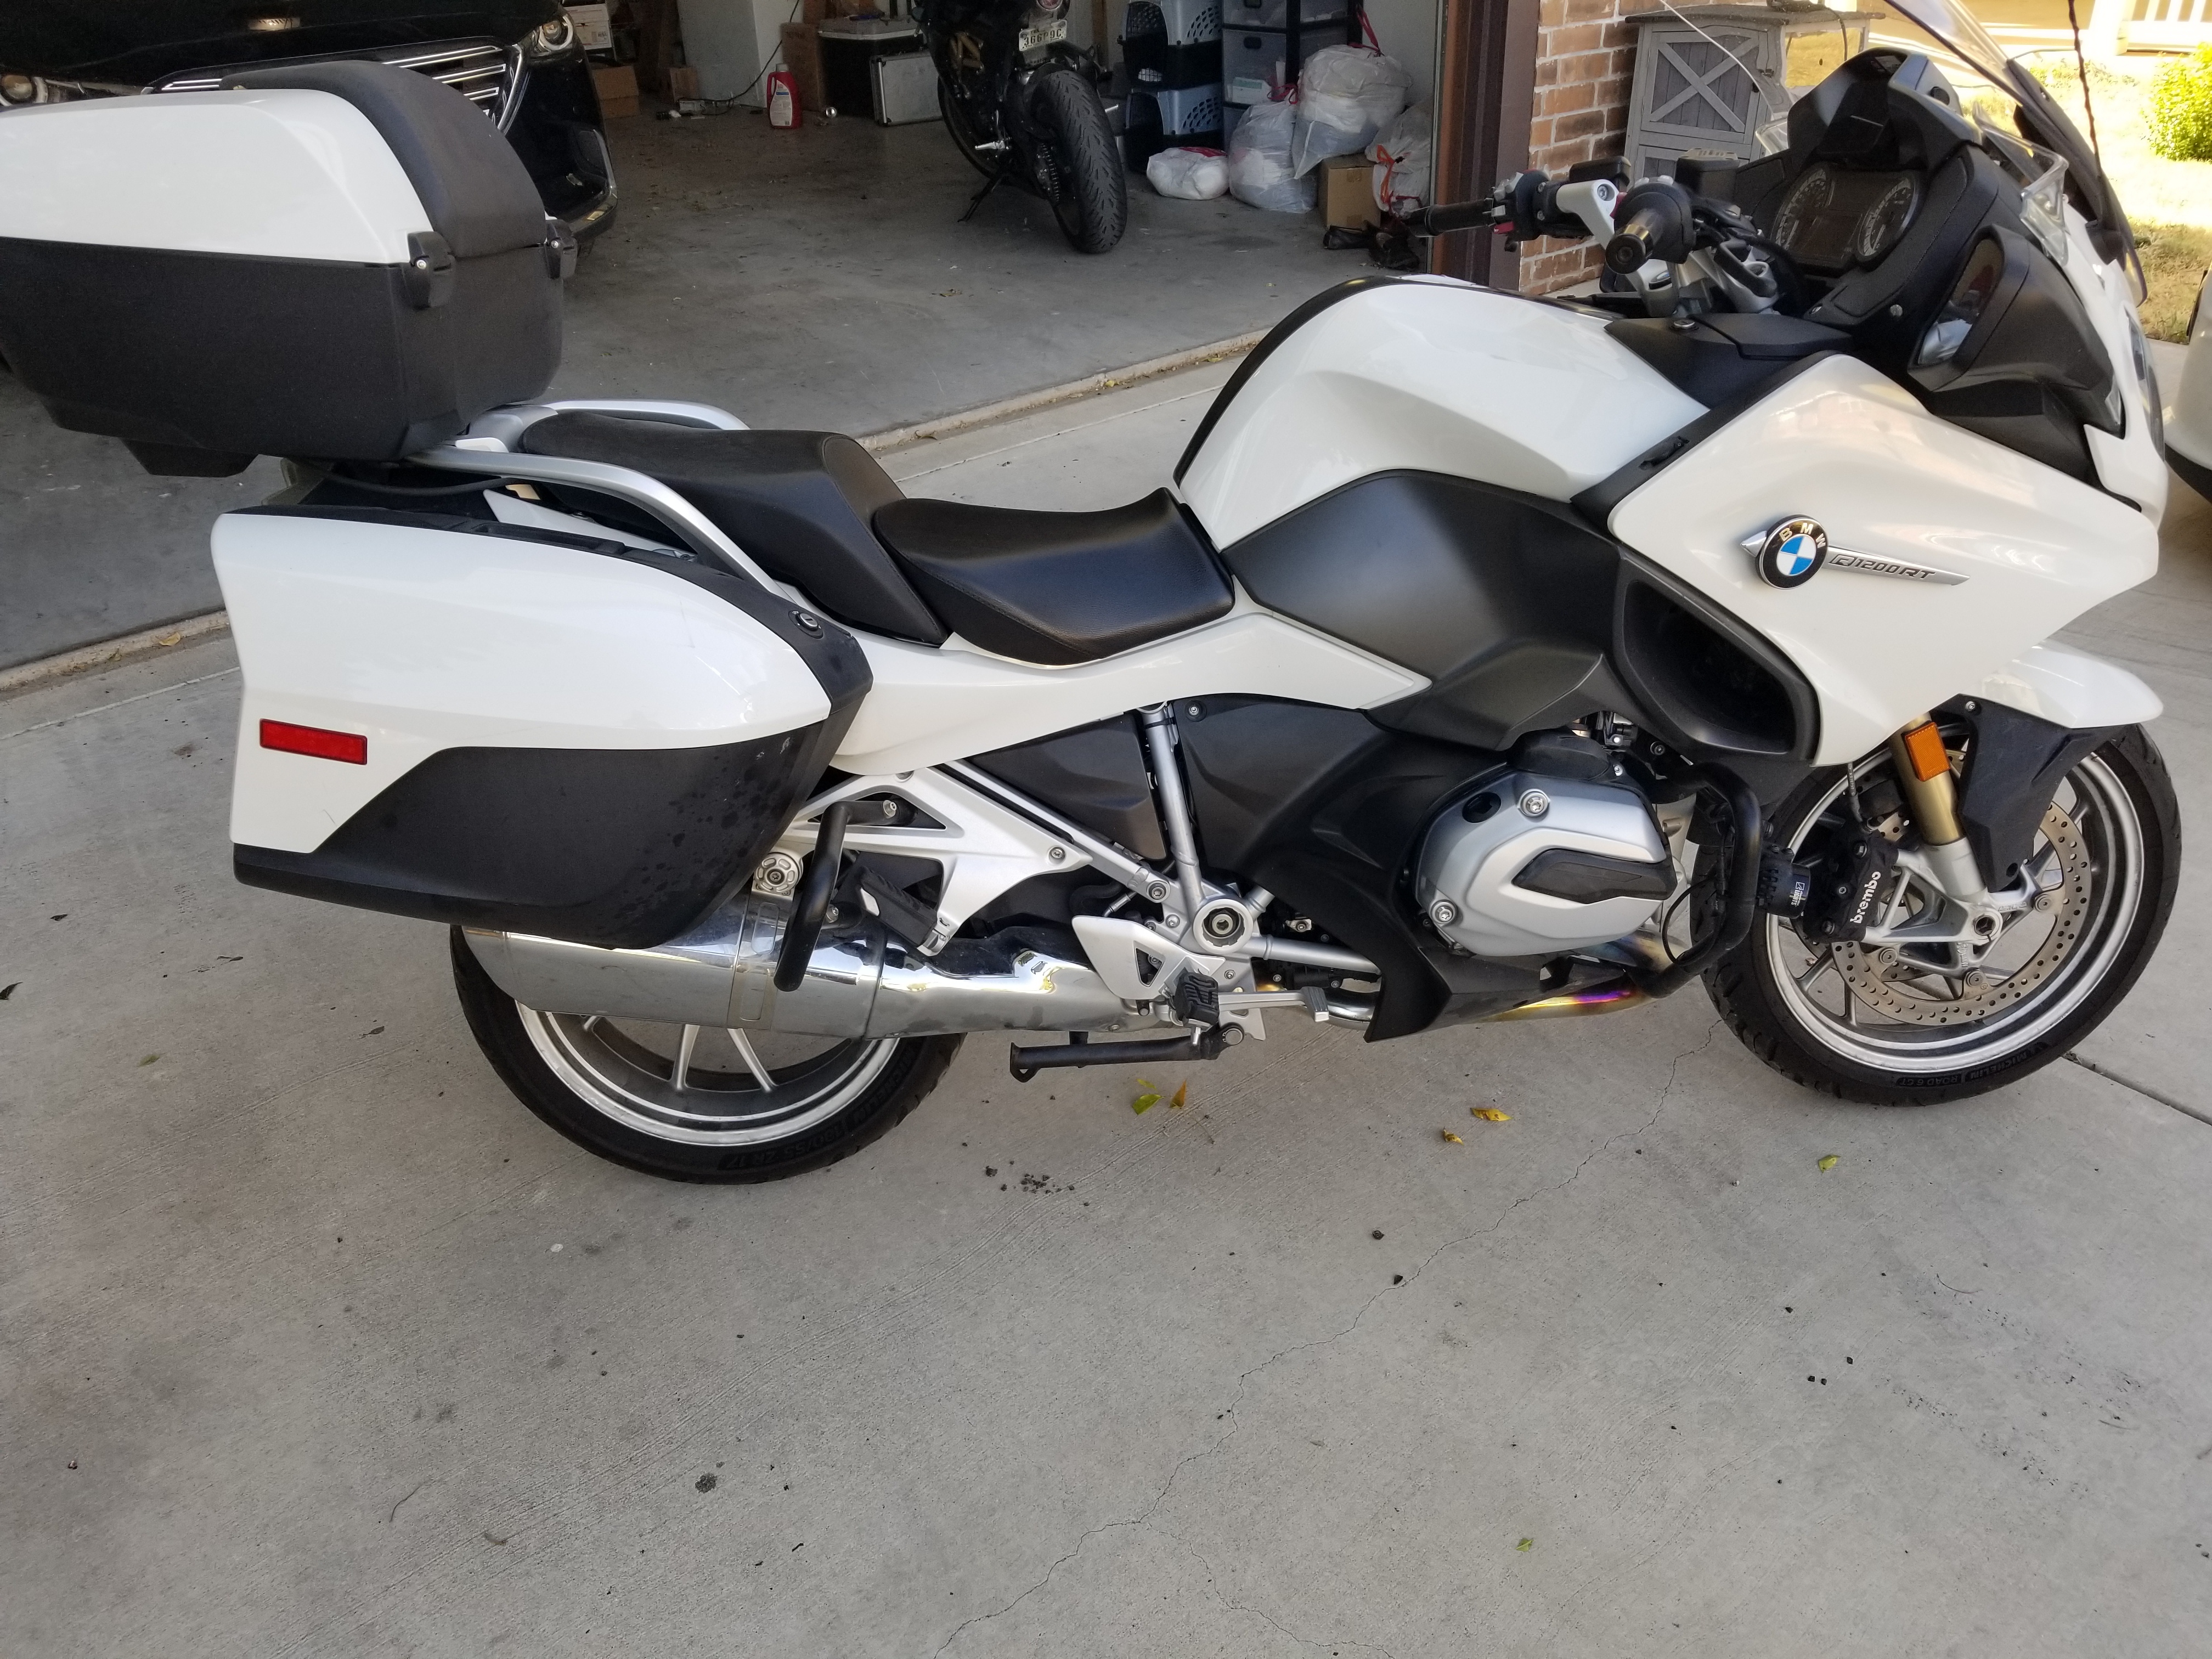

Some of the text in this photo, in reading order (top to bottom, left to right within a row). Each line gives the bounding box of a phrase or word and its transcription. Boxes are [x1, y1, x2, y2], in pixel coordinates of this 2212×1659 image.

[1779, 522, 1826, 549] BMW
[1829, 554, 1936, 580] R1200RT
[1849, 871, 1881, 924] brembo
[1970, 1052, 2027, 1080] MICHELIN
[1898, 1078, 1915, 1086] GT
[1927, 1075, 1958, 1086] ROAD
